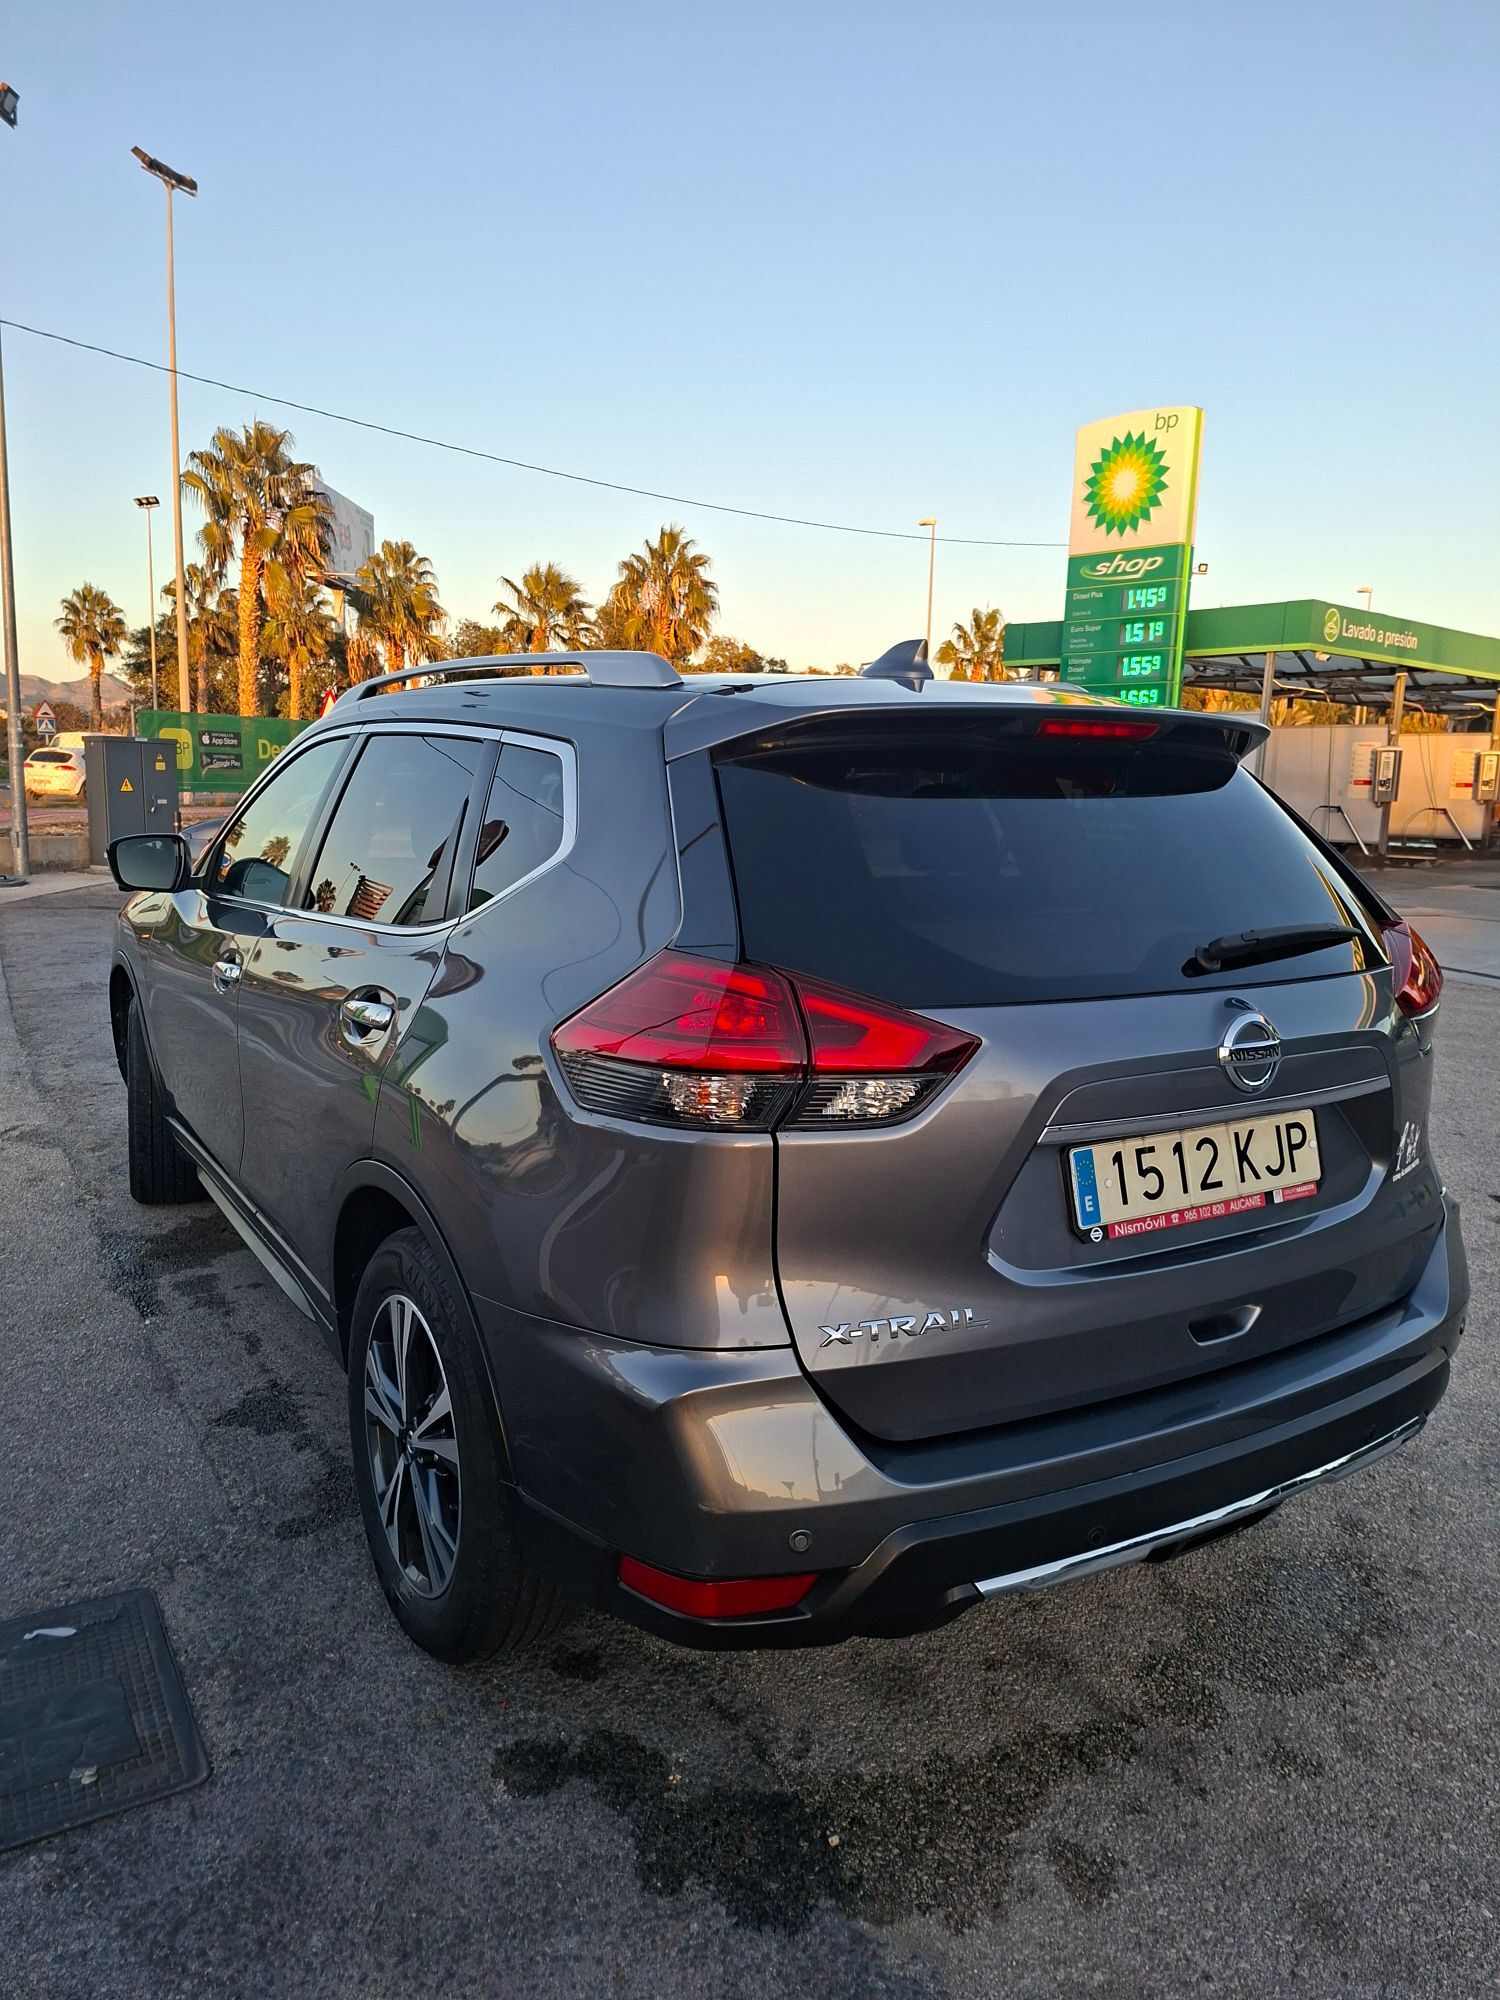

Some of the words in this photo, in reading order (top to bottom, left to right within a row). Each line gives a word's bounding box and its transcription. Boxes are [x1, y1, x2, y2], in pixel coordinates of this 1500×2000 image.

[1155, 412, 1179, 433] bp
[1093, 554, 1164, 579] shop
[1341, 618, 1376, 642] Lavado
[1377, 630, 1384, 643] a
[1384, 630, 1418, 649] presión
[212, 738, 223, 746] App
[224, 738, 239, 746] Store
[213, 759, 230, 767] Google
[230, 760, 241, 768] Play
[1229, 1044, 1280, 1062] NISSAN
[1111, 1136, 1224, 1206] 1512
[1234, 1121, 1308, 1184] KJP
[1084, 1195, 1094, 1212] E
[1114, 1215, 1166, 1236] Nismóvil
[1184, 1209, 1198, 1221] 965
[1199, 1207, 1211, 1218] 102
[1212, 1204, 1225, 1216] 820
[1230, 1197, 1262, 1212] ALICANTE
[818, 1307, 992, 1348] X-TRAIL
